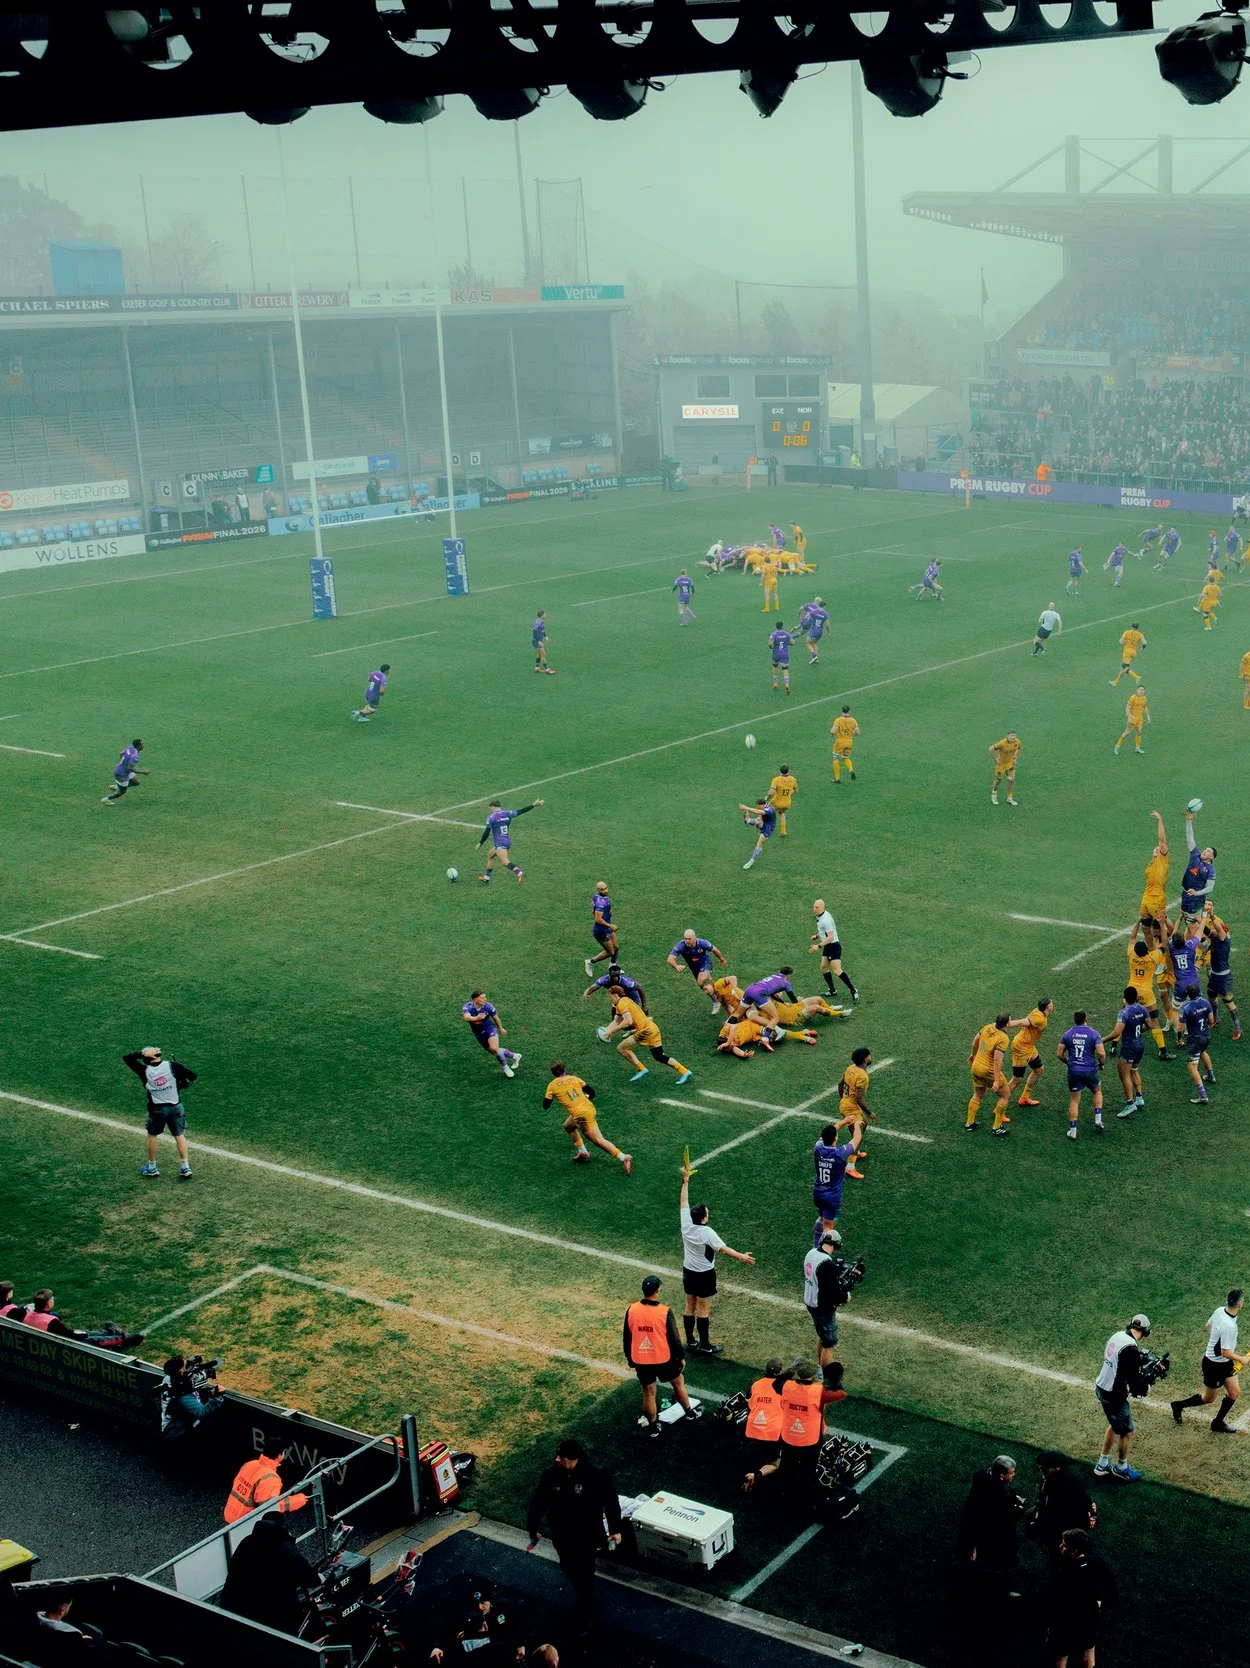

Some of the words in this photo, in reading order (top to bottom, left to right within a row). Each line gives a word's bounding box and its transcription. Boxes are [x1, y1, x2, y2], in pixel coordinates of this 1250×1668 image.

[254, 295, 288, 307] OTTER
[454, 289, 493, 303] KAS
[55, 299, 110, 311] SPIERS
[121, 299, 147, 309] EXETER
[148, 299, 169, 309] GOLF
[170, 299, 177, 307] &
[177, 298, 212, 307] COUNTRY
[213, 298, 231, 306] CLUB
[683, 407, 737, 417] CARYSIL
[772, 421, 781, 432] 0
[802, 421, 811, 432] 0
[472, 455, 479, 463] D
[222, 468, 249, 480] BAKER
[162, 484, 171, 496] C
[185, 483, 195, 496] C
[950, 477, 983, 491] PREM
[984, 480, 1027, 495] RUGBY
[1028, 482, 1053, 496] CUP
[1120, 487, 1147, 496] PREM
[1120, 496, 1152, 508] RUGBY
[1153, 499, 1171, 509] CUP
[213, 529, 242, 539] FINAL
[241, 525, 266, 537] 2026
[35, 541, 119, 562] WOLLENS
[500, 825, 508, 835] 13
[1177, 956, 1188, 970] 19
[1074, 1045, 1084, 1058] 17
[565, 1088, 580, 1103] 14
[818, 1167, 831, 1183] 16
[28, 1338, 57, 1361] DAY
[61, 1349, 98, 1373] SKIP
[100, 1361, 140, 1390] HIRE
[756, 1396, 772, 1404] WATER
[788, 1403, 809, 1412] DOCTOR
[663, 1505, 701, 1523] Pennon
